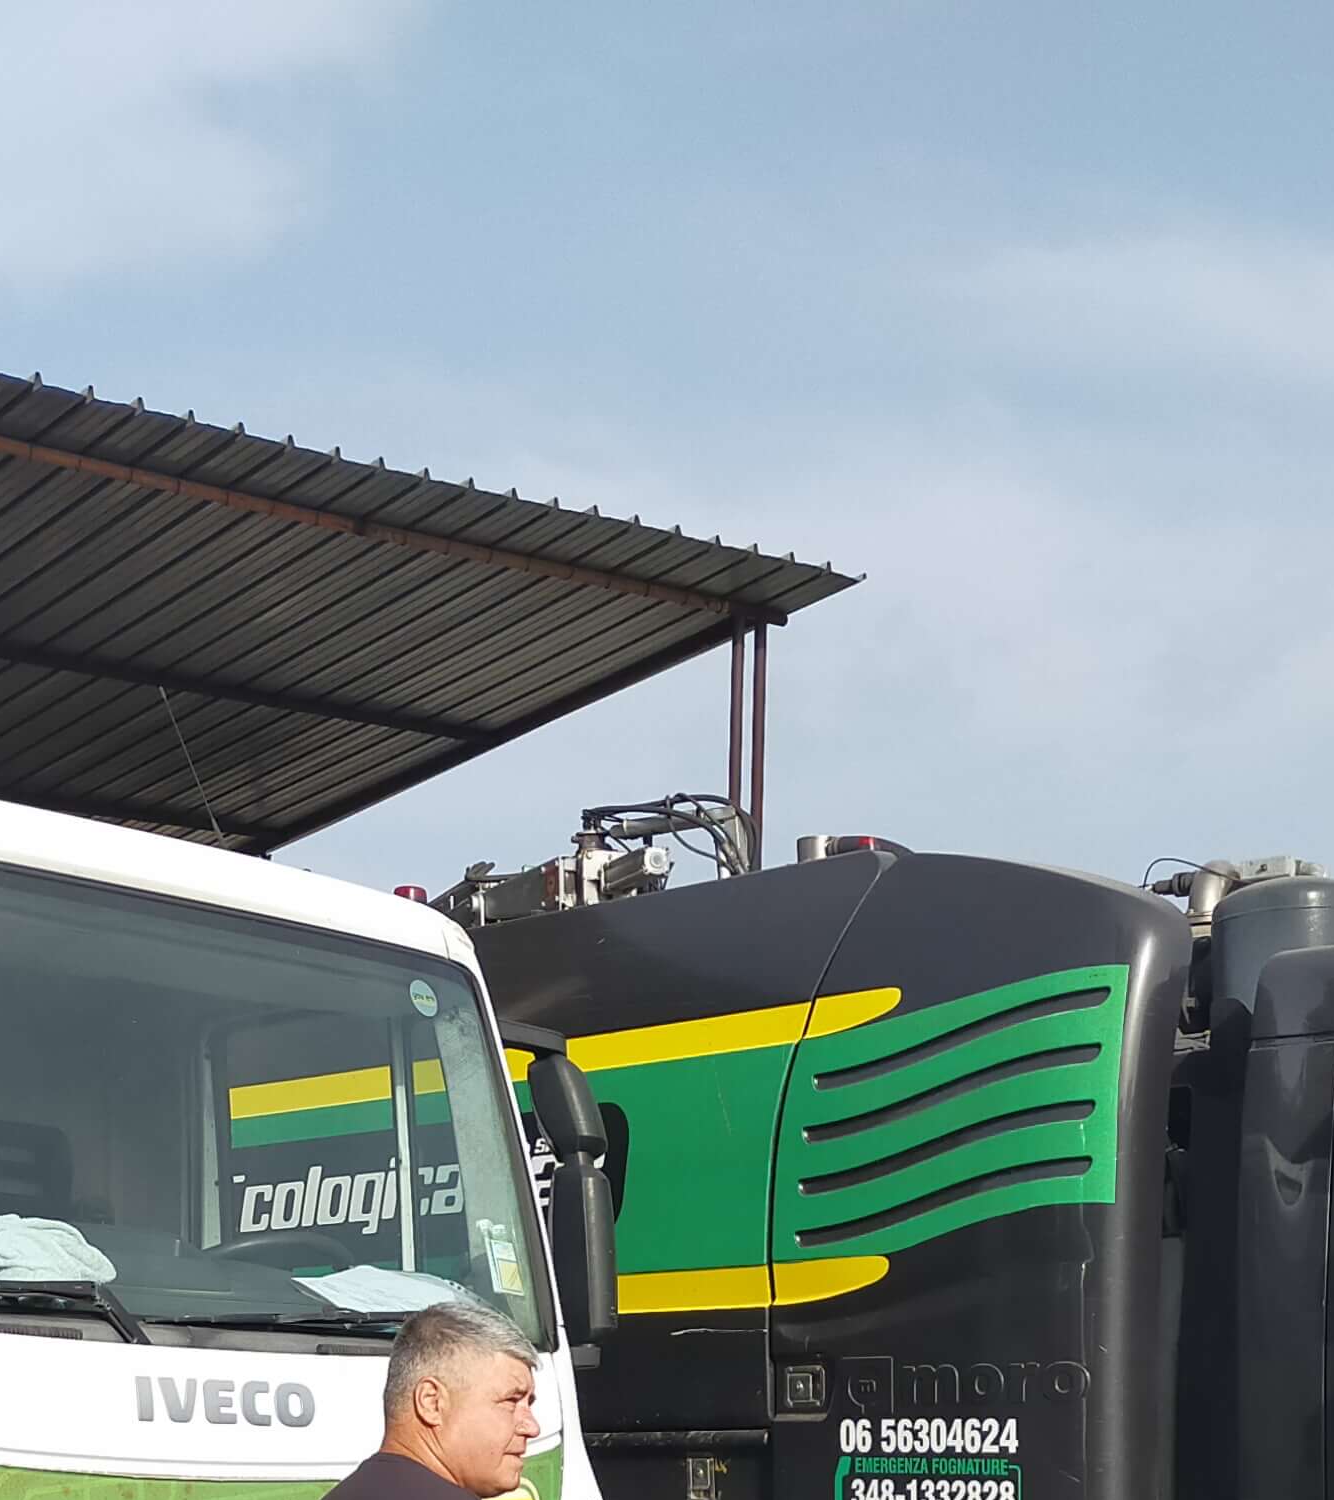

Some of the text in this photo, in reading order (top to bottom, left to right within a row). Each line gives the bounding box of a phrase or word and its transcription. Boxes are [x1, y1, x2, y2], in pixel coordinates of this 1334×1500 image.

[134, 1375, 316, 1428] IVECO
[901, 1360, 1091, 1405] moro
[839, 1418, 1020, 1454] 06 56304624
[854, 1456, 1010, 1477] EMERGENZA FOGNATURE
